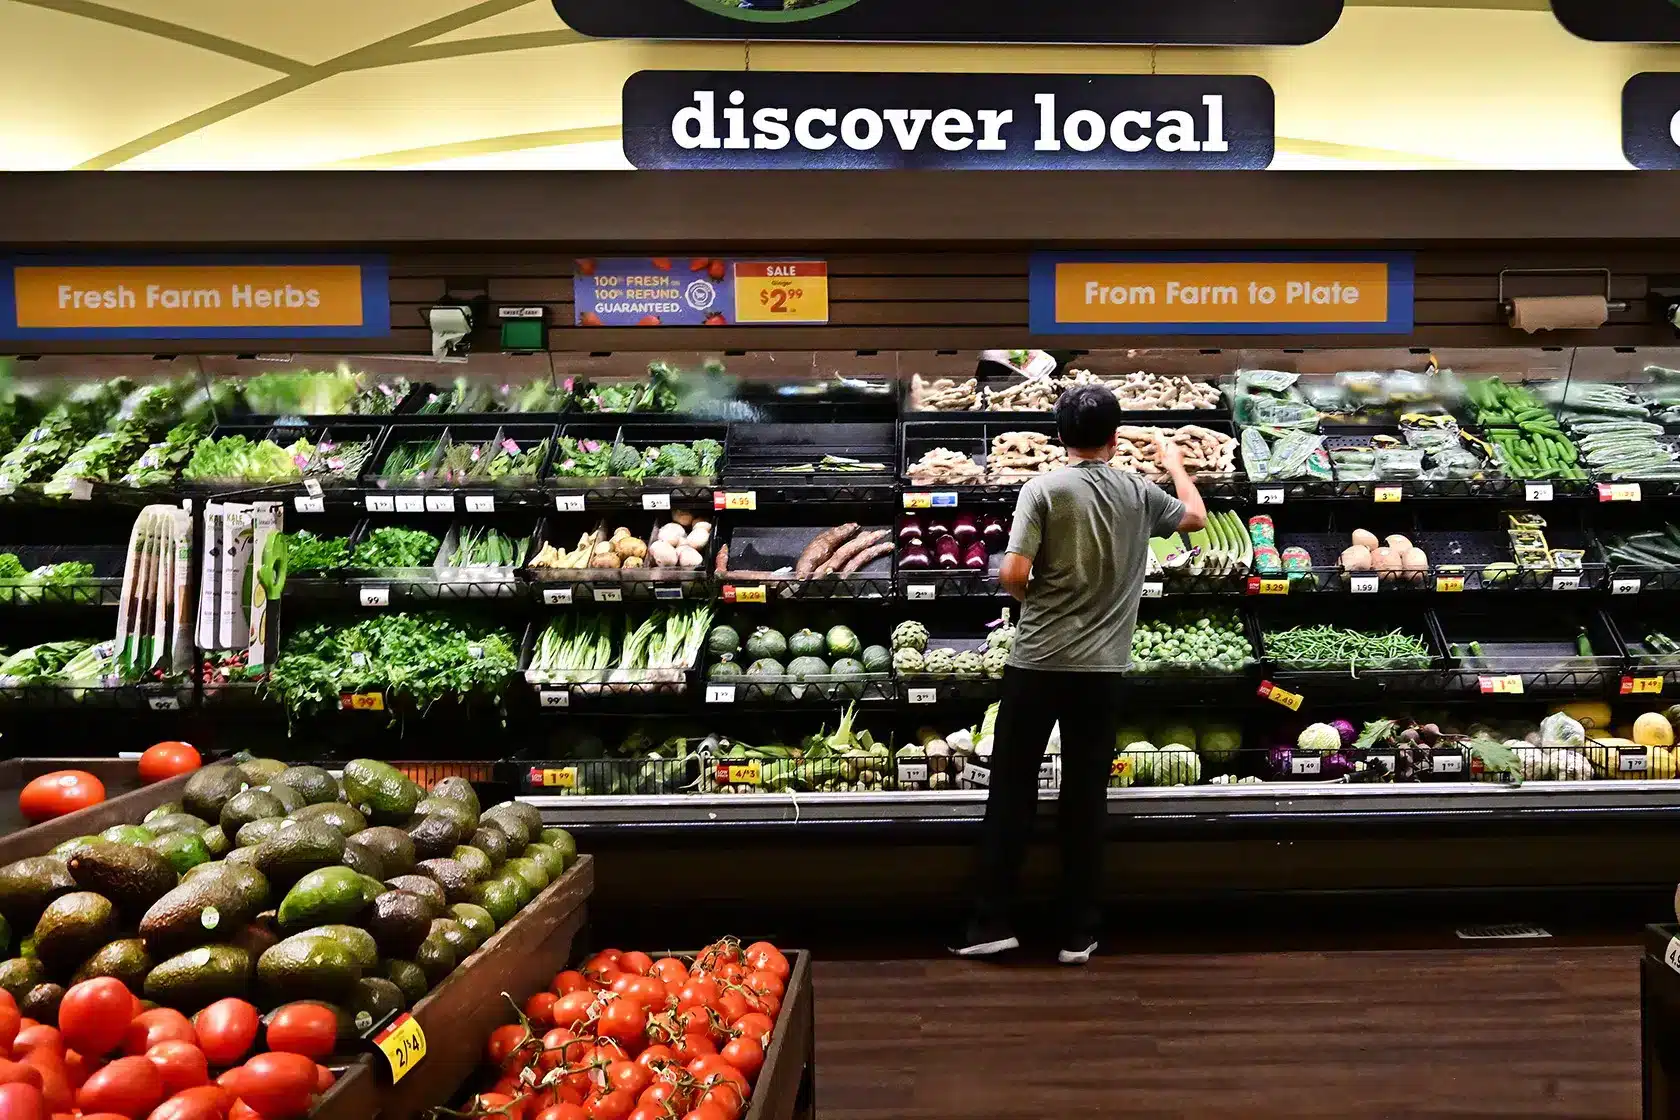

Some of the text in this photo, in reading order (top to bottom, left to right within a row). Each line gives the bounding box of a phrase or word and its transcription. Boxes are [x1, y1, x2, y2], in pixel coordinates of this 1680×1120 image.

[672, 91, 1229, 152] discover local
[767, 265, 797, 277] SALE
[594, 277, 624, 286] 100
[626, 277, 669, 287] FRESH
[58, 285, 321, 309] Fresh Farm Herbs
[626, 289, 682, 300] REFUND.
[1085, 281, 1360, 305] From Farm to Plate
[595, 302, 683, 313] GUARANTEED.
[1266, 583, 1284, 591] 3.29
[1357, 584, 1373, 592] 1.99
[742, 591, 760, 600] 3.29
[1275, 693, 1293, 706] 2.49
